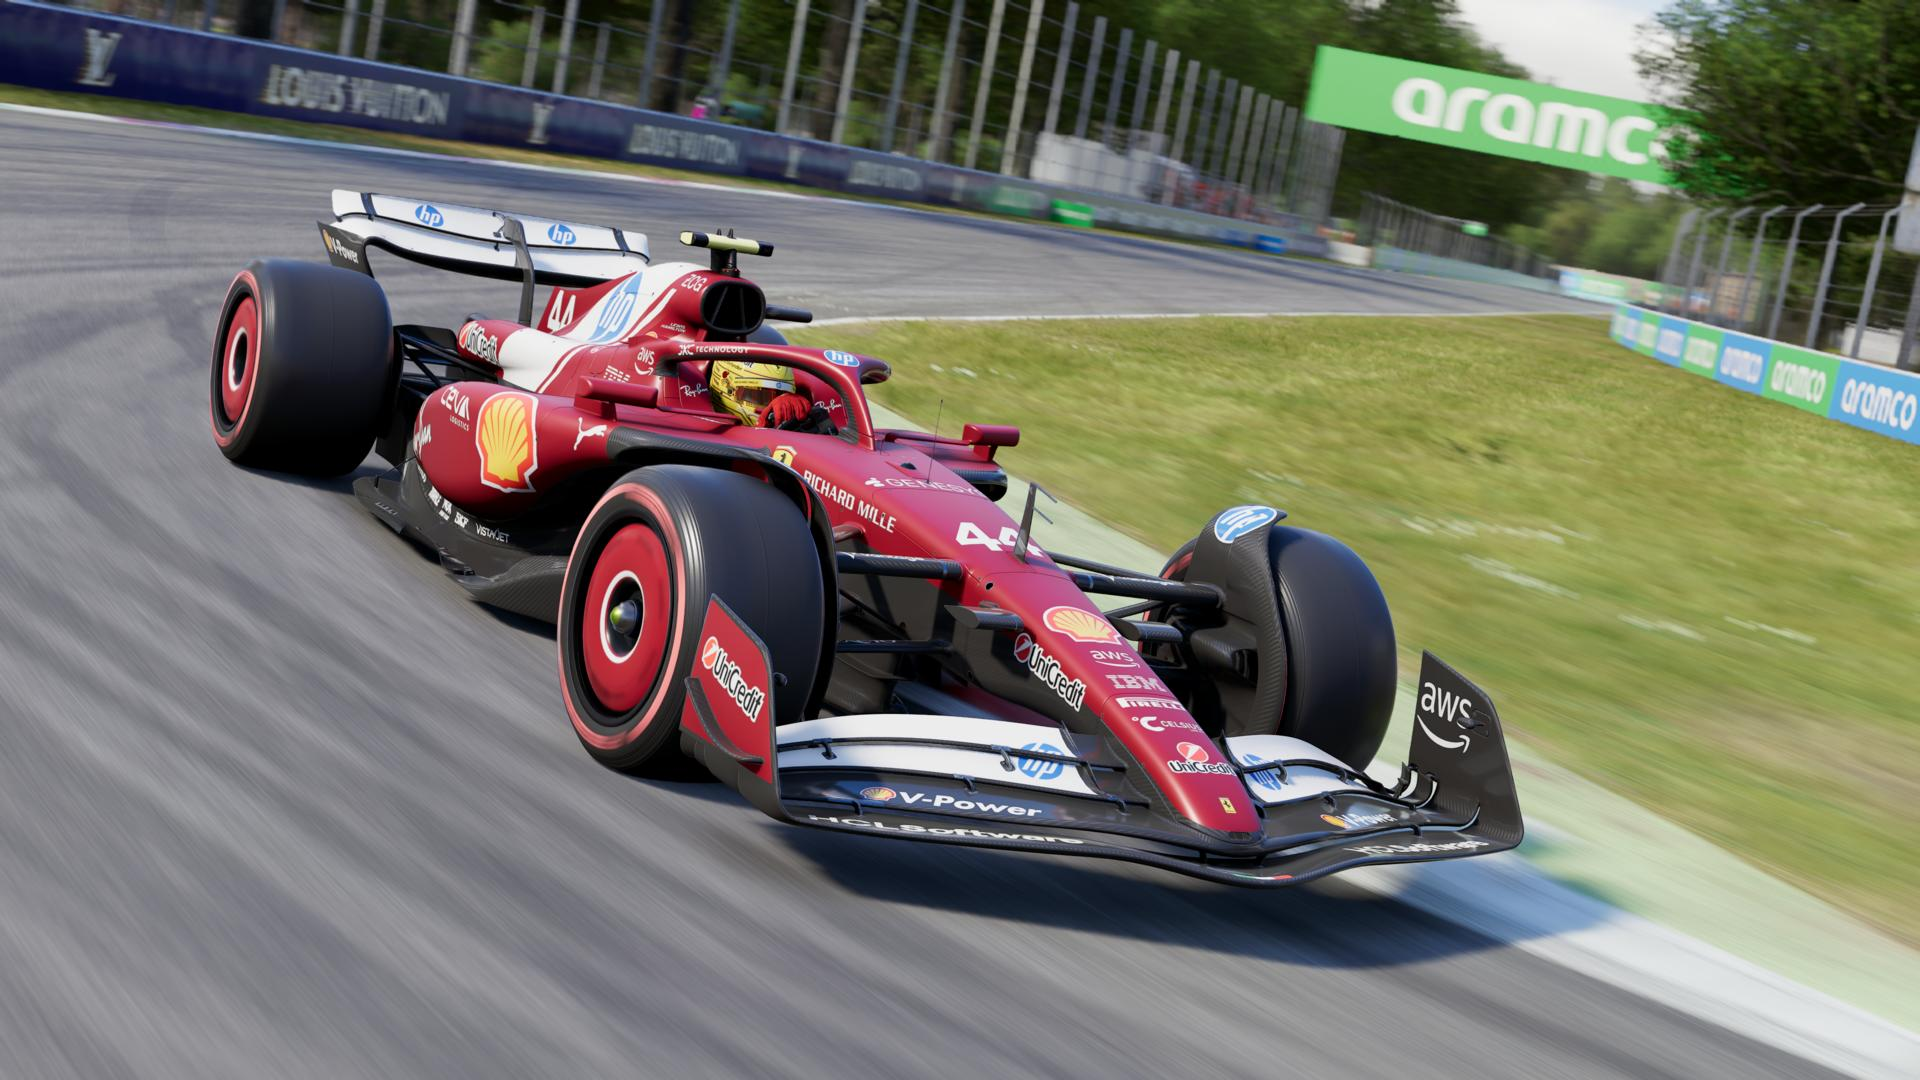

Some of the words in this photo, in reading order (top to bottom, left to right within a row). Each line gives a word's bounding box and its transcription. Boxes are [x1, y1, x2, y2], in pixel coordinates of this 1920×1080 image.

[418, 204, 442, 226] hp
[330, 235, 359, 264] V-Power
[551, 224, 575, 245] hp
[547, 289, 577, 332] 44
[592, 275, 638, 341] hp
[466, 323, 498, 366] UniCredit
[637, 347, 655, 366] aws
[696, 345, 749, 354] TECHNOLOGY
[829, 350, 856, 367] hp
[1771, 360, 1827, 404] aramco
[441, 386, 470, 421] CEVA
[1840, 378, 1918, 430] aramco
[803, 470, 856, 511] RICHARD
[857, 500, 897, 533] MILLE
[955, 522, 1043, 557] 44
[1219, 507, 1271, 541] hp
[1090, 650, 1134, 662] aws
[714, 649, 763, 720] UniCredit
[1029, 645, 1084, 710] UniCredit
[1105, 674, 1168, 693] IBM
[1421, 682, 1472, 729] aws
[899, 791, 1043, 817] V-Power
